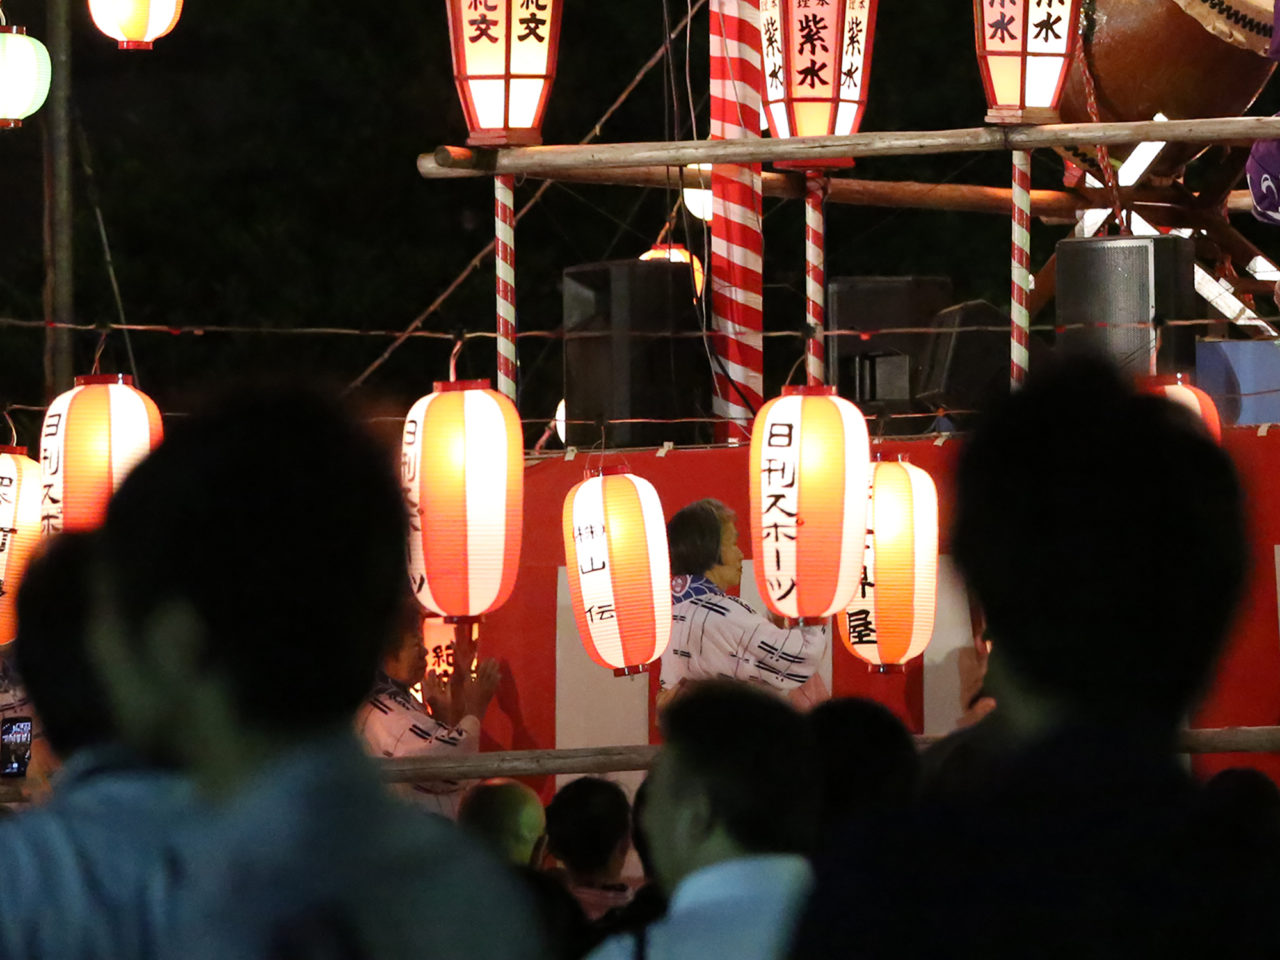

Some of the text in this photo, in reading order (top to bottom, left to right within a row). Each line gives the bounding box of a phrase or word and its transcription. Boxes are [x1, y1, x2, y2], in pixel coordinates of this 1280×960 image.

[764, 16, 783, 90] 紫水
[796, 13, 829, 89] 紫水
[841, 16, 863, 89] 紫水
[761, 423, 804, 601] 日刊スポーツ
